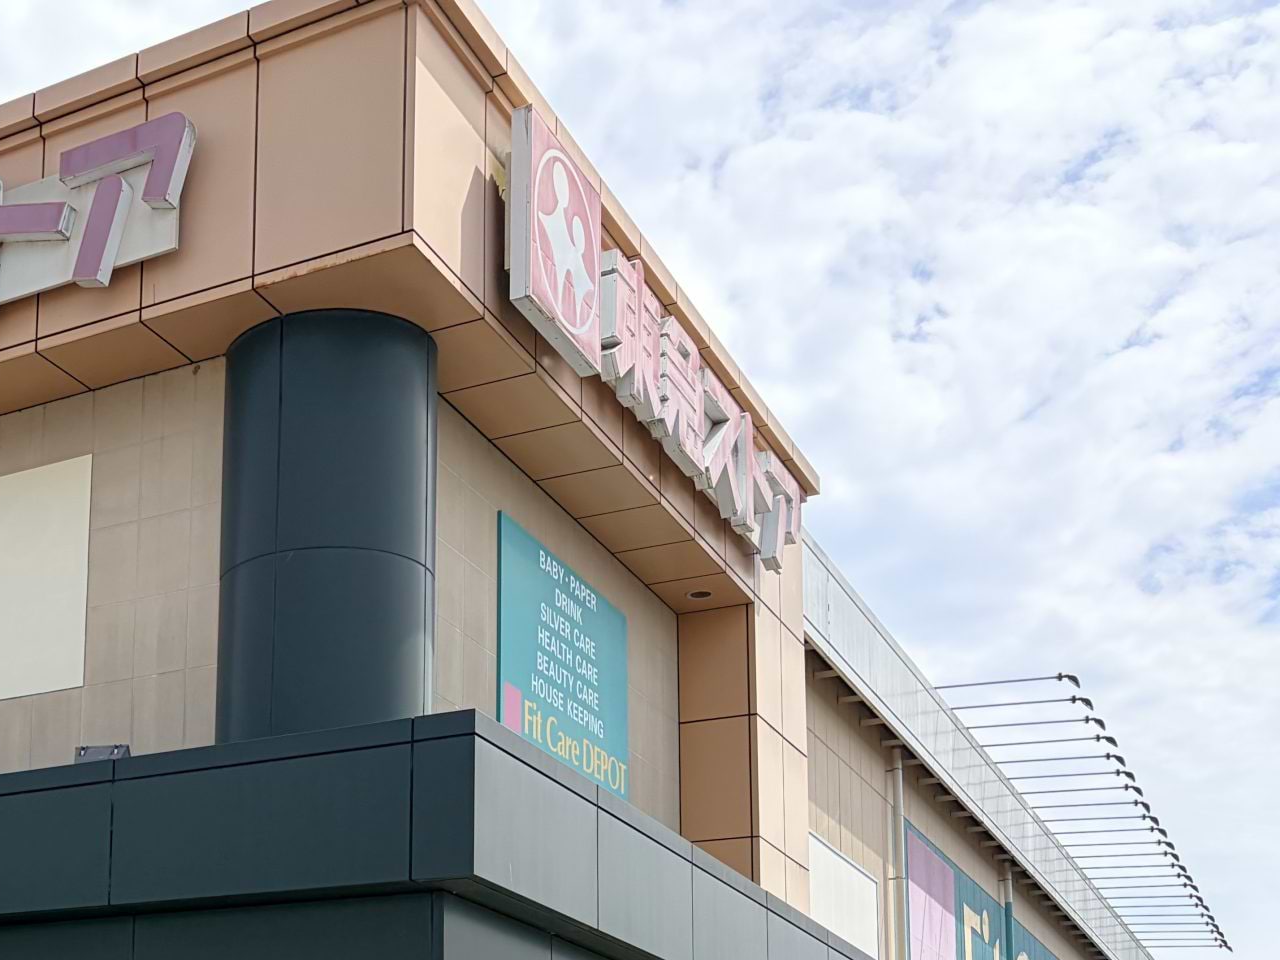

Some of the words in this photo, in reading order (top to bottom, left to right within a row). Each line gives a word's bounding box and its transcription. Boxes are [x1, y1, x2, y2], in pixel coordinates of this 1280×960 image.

[601, 249, 802, 571] 東急ストア
[540, 603, 571, 639] SILVER
[573, 629, 596, 660] CARE
[555, 588, 583, 625] DRINK
[537, 651, 574, 690] BEAUTY
[576, 682, 599, 712] CARE
[538, 625, 572, 665] HEALTH
[575, 656, 598, 686] CARE
[531, 673, 564, 711] HOUSE
[567, 697, 604, 739] KEEPING
[524, 699, 543, 744] Fit
[546, 715, 579, 766] Care
[582, 740, 627, 795] DEPOT
